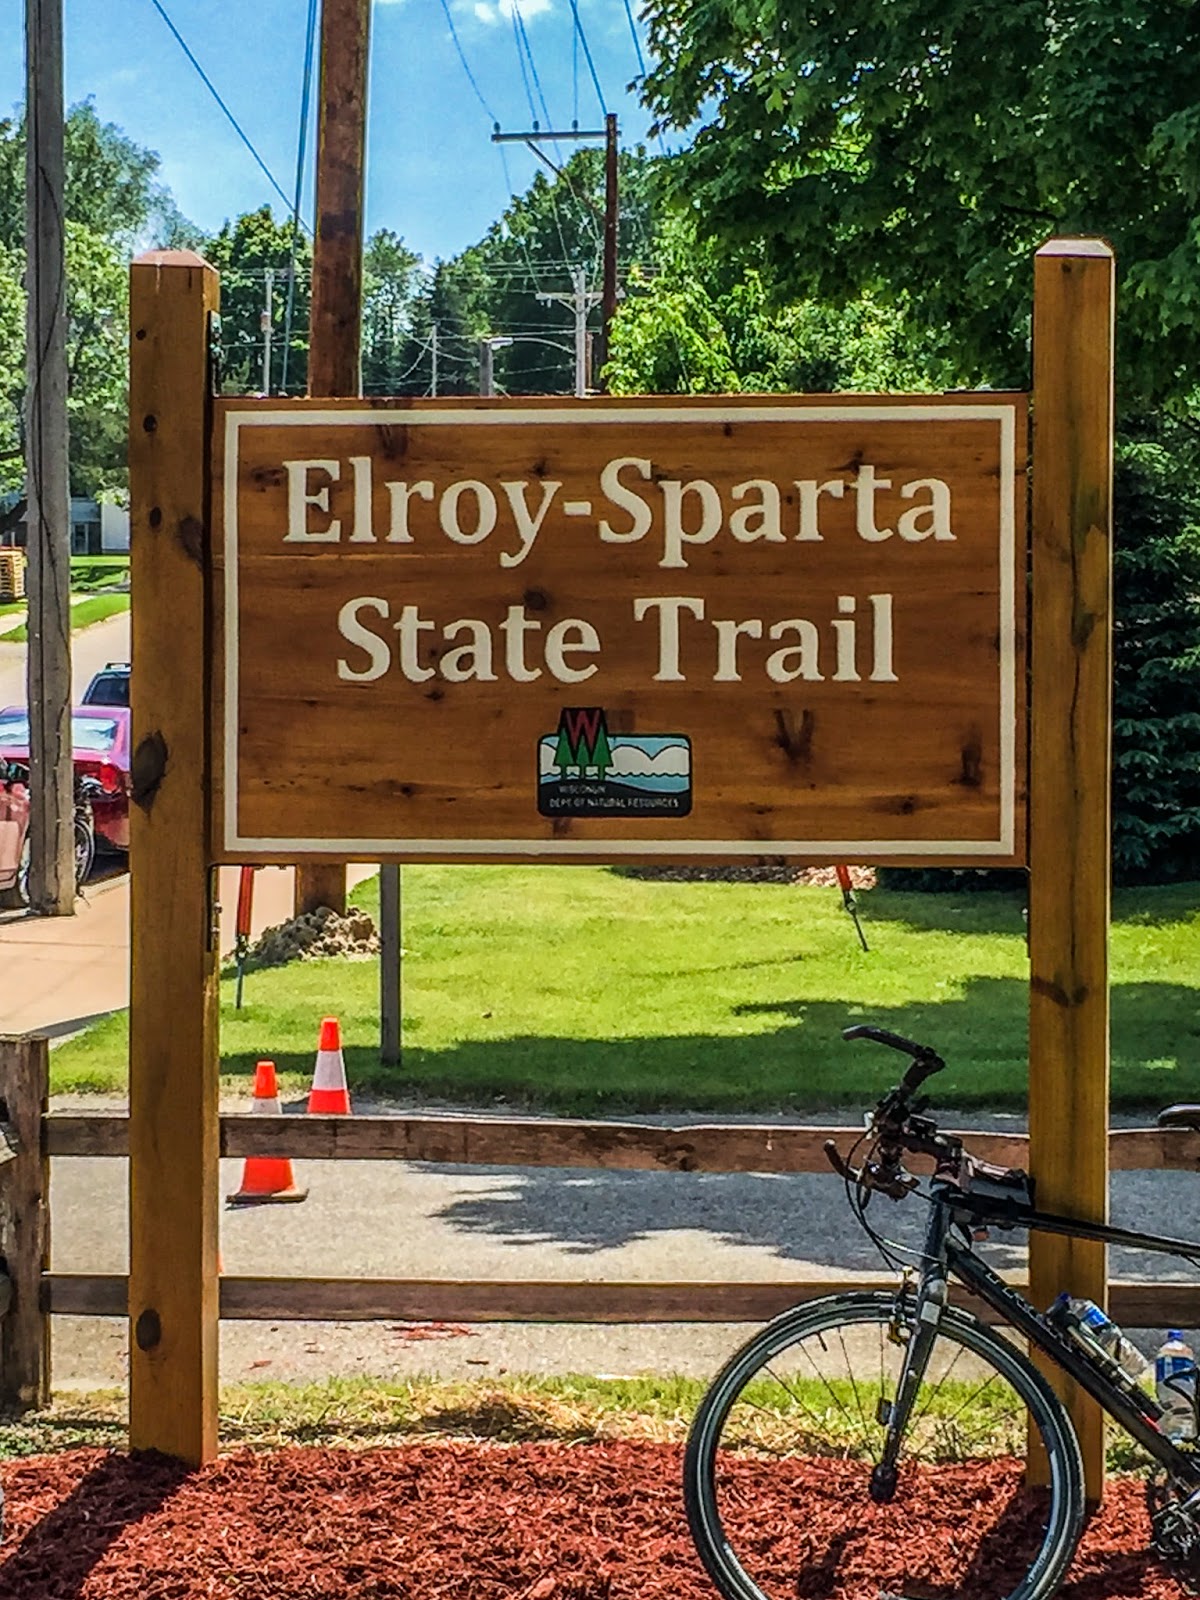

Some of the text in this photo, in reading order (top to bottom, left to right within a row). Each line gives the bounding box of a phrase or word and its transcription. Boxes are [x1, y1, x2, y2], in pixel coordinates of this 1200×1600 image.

[283, 456, 957, 568] Elroy-Sparta
[337, 594, 899, 683] State Trail
